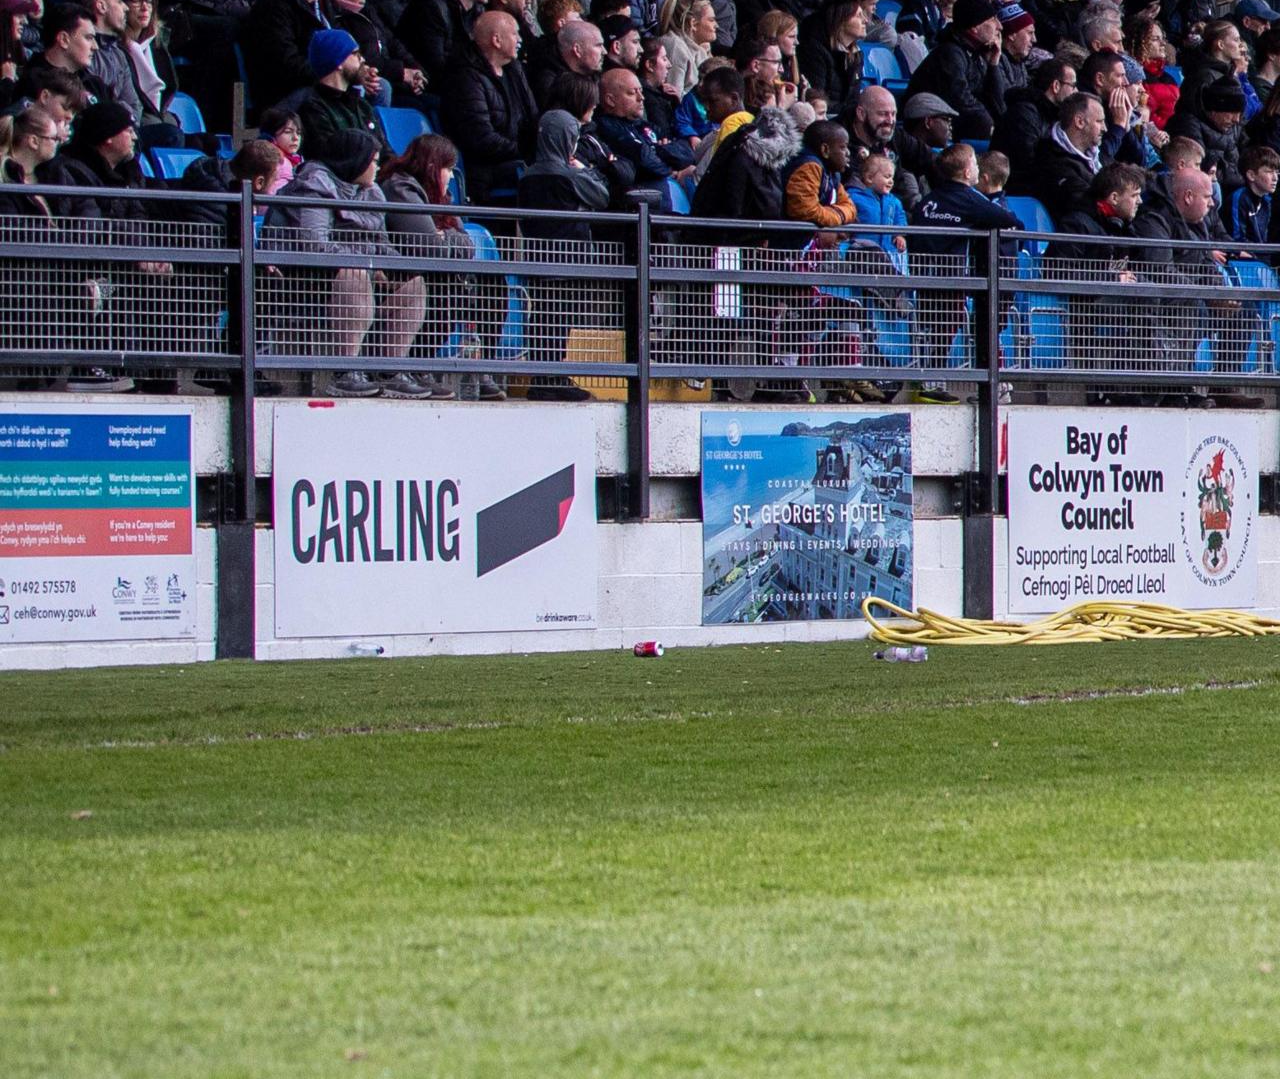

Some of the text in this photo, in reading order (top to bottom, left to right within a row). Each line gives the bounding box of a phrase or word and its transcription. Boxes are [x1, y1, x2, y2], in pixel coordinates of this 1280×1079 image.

[930, 211, 961, 223] GeoPro
[1066, 424, 1128, 462] Bay of
[1028, 461, 1164, 500] Colwyn Town
[290, 478, 461, 564] CARLING
[733, 502, 886, 525] ST. GEORGE'S HOTEL
[1060, 496, 1135, 531] Council
[721, 538, 901, 552] STAYS DINING EVENTS WEDDINGS
[1016, 542, 1176, 571] Supporting Local Football
[11, 579, 77, 595] 01492 575578
[1022, 573, 1166, 601] Cefnogi Pêl Droed Lleol
[14, 604, 97, 622] ceh@conwy.gov.uk
